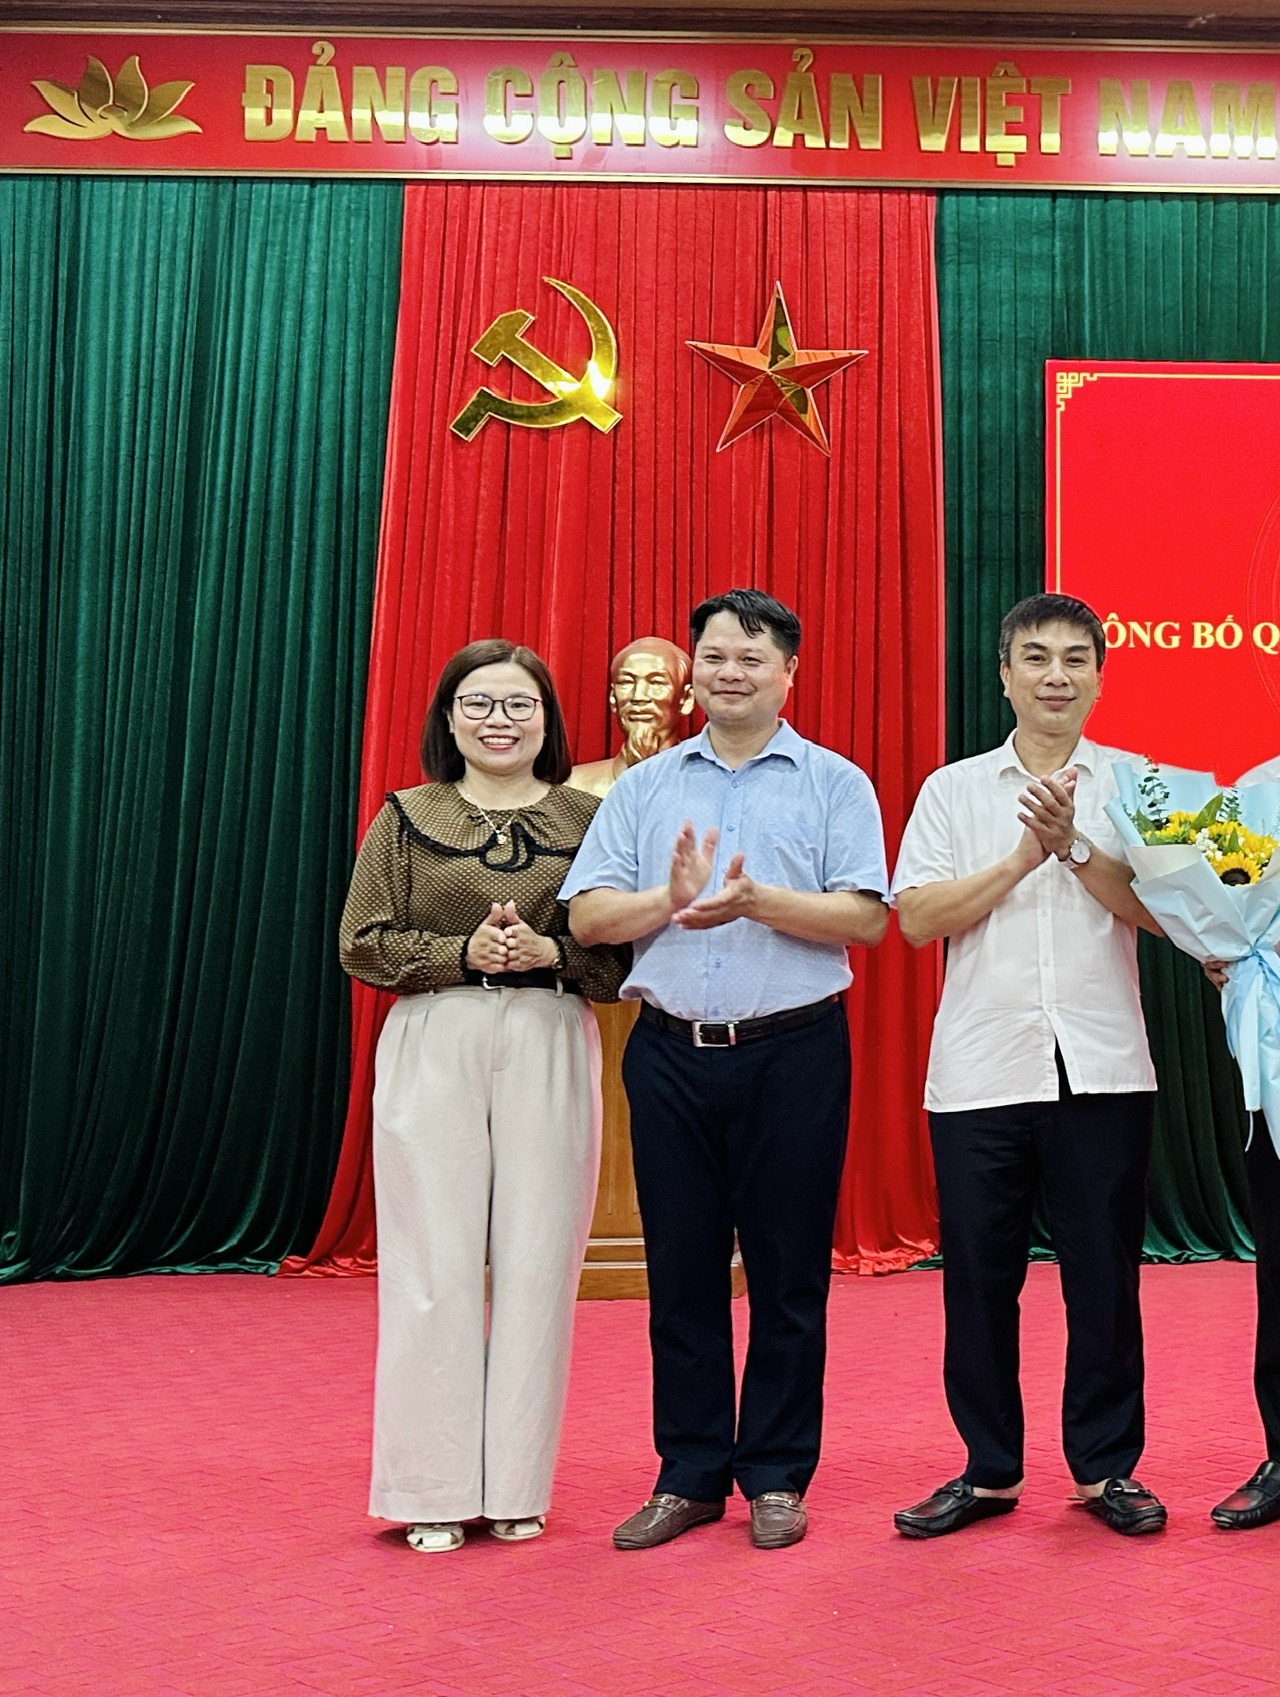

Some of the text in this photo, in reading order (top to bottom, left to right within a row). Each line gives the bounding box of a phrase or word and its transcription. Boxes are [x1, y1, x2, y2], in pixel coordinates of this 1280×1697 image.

[242, 41, 461, 143] ĐẢNG
[483, 51, 700, 159] CỘNG
[724, 47, 883, 151] SẢN
[910, 62, 1072, 167] VIỆT
[1097, 78, 1279, 159] NAM
[1102, 612, 1181, 649] ÔNG
[1191, 614, 1243, 650] BỐ
